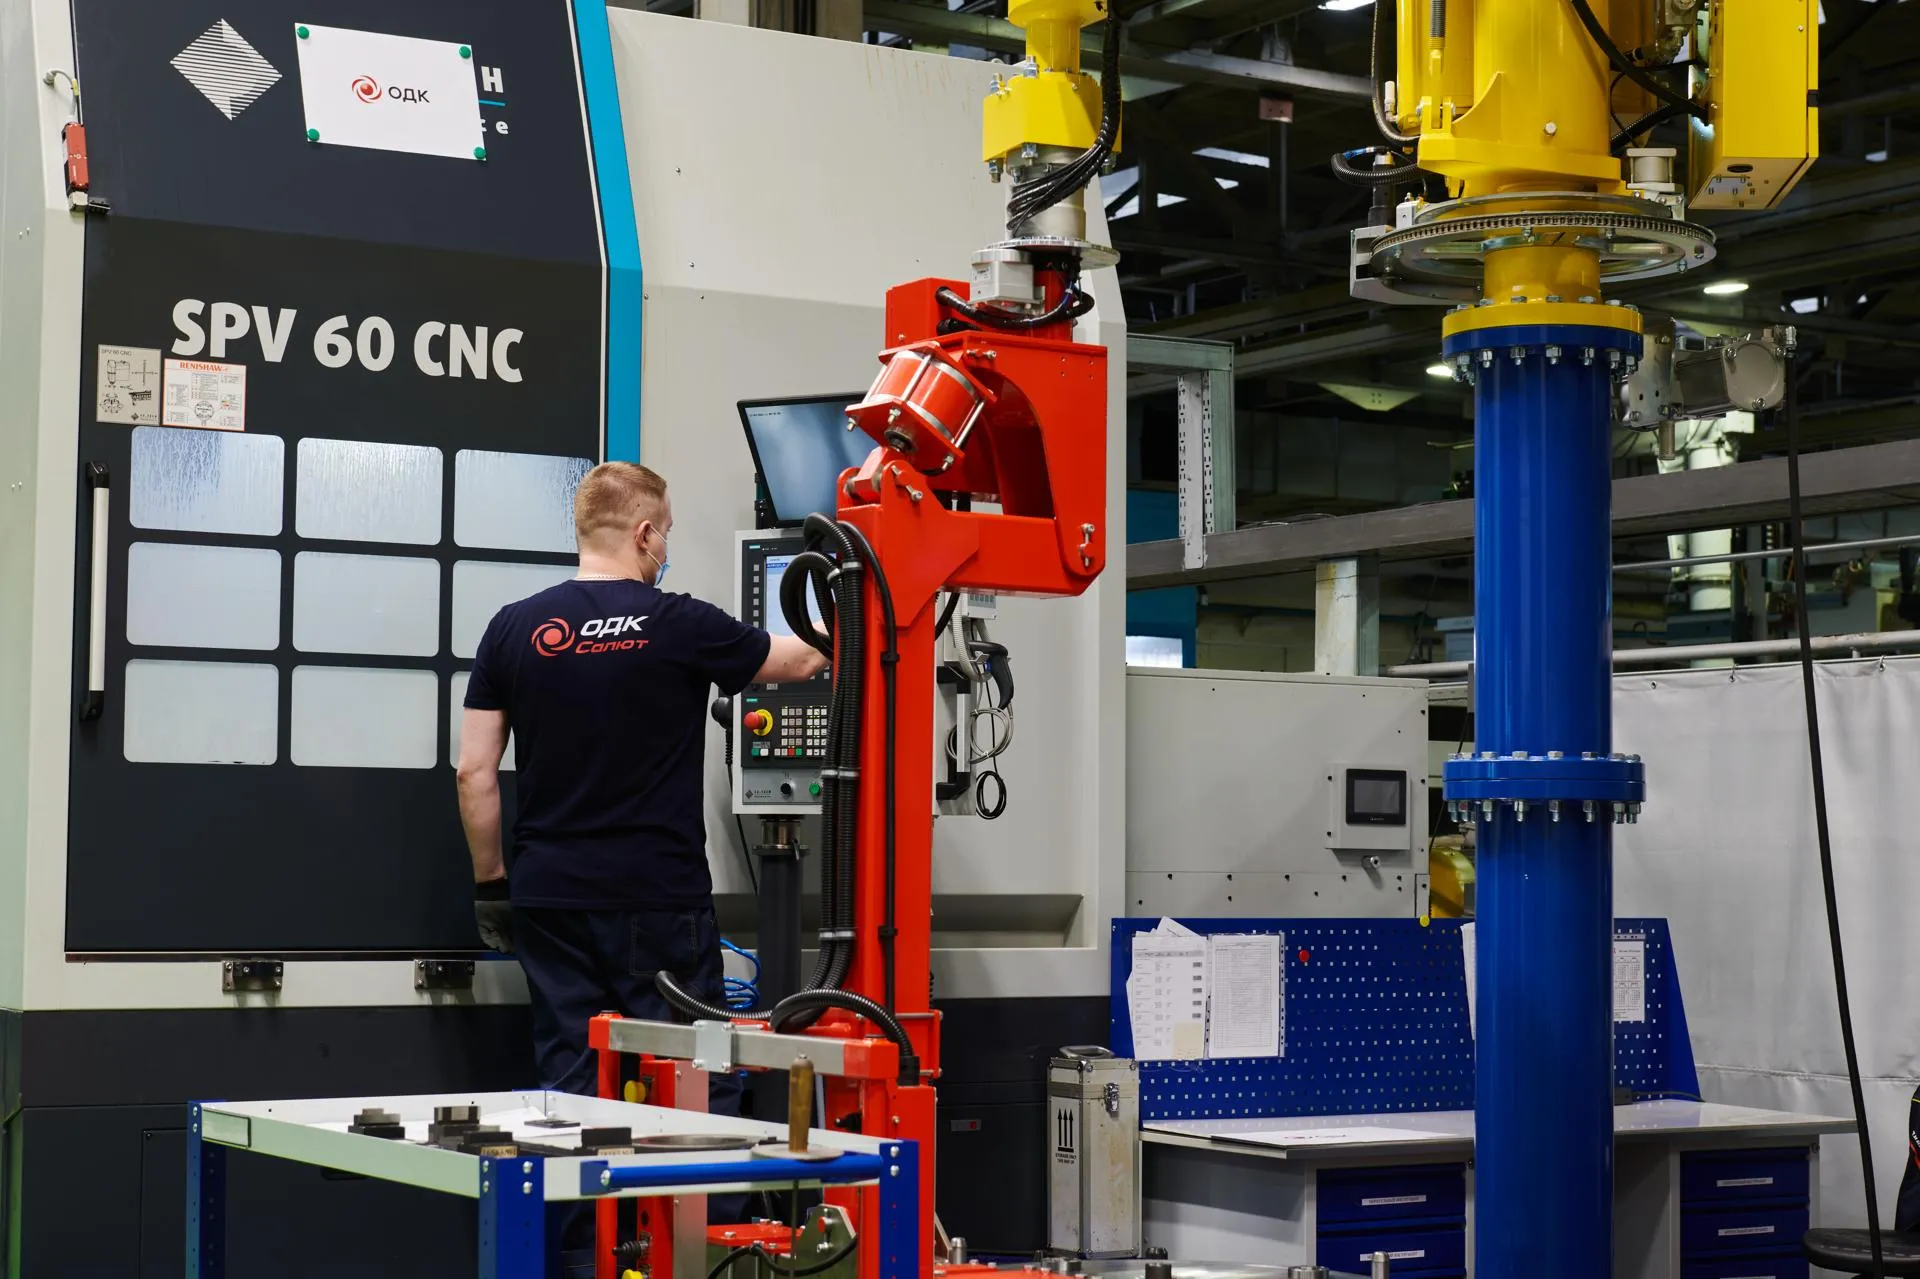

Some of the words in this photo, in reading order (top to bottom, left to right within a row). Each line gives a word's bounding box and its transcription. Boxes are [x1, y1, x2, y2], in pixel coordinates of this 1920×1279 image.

[388, 86, 430, 104] ОДК
[171, 298, 297, 363] SPV
[313, 315, 395, 372] 60
[414, 321, 524, 383] CNC
[179, 361, 223, 372] RENISHAW
[580, 615, 649, 638] ОДК
[575, 639, 649, 654] Салют
